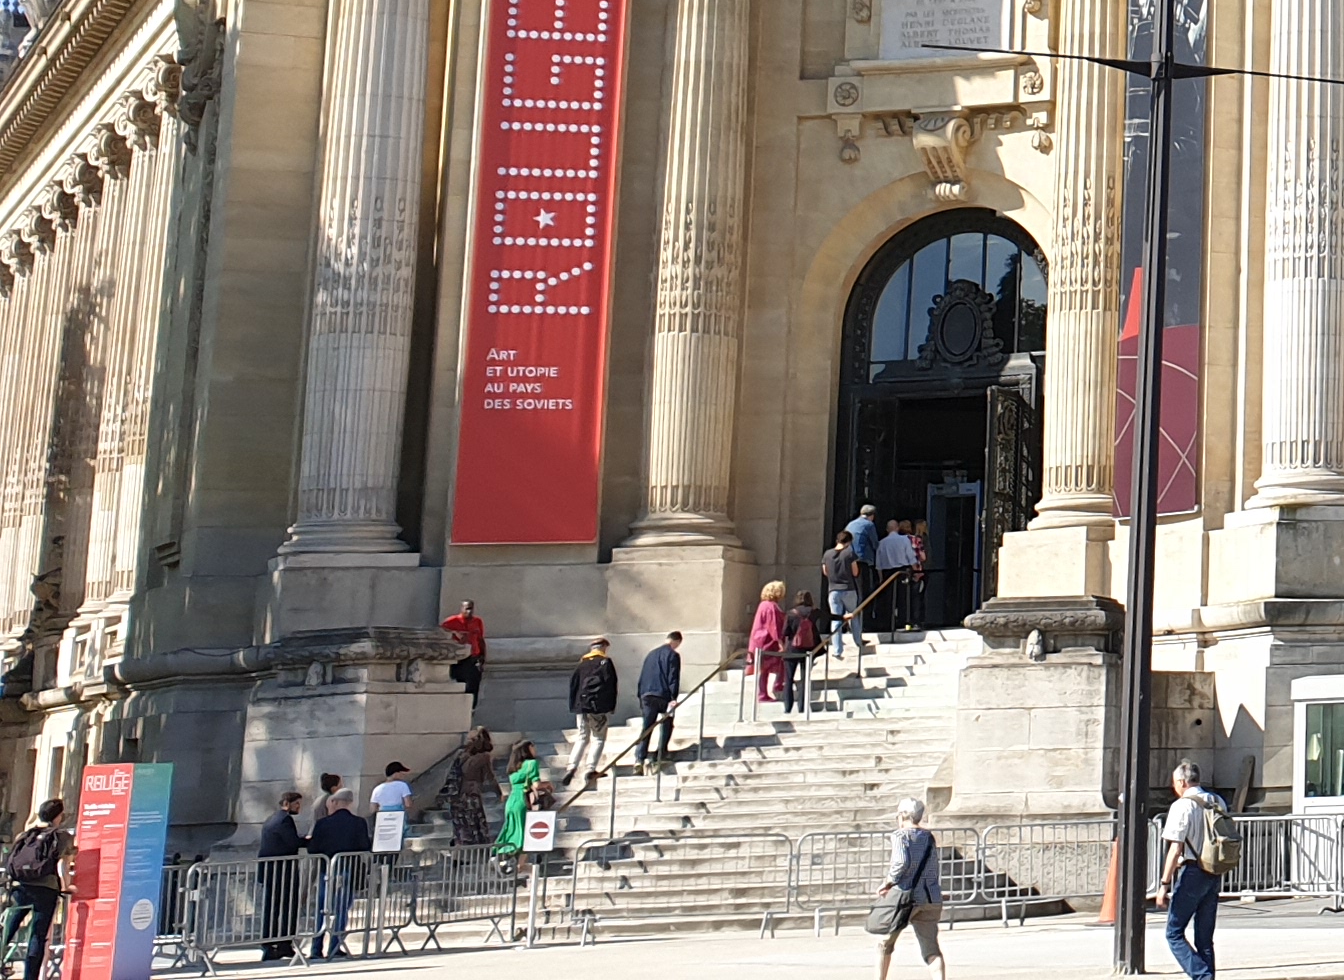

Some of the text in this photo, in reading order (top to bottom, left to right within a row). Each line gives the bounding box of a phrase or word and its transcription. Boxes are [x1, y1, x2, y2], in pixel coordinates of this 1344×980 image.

[486, 348, 518, 361] ART
[486, 366, 559, 377] ET UTOPIE
[484, 383, 542, 393] AU PAYS
[484, 399, 573, 410] DES SOVIETS
